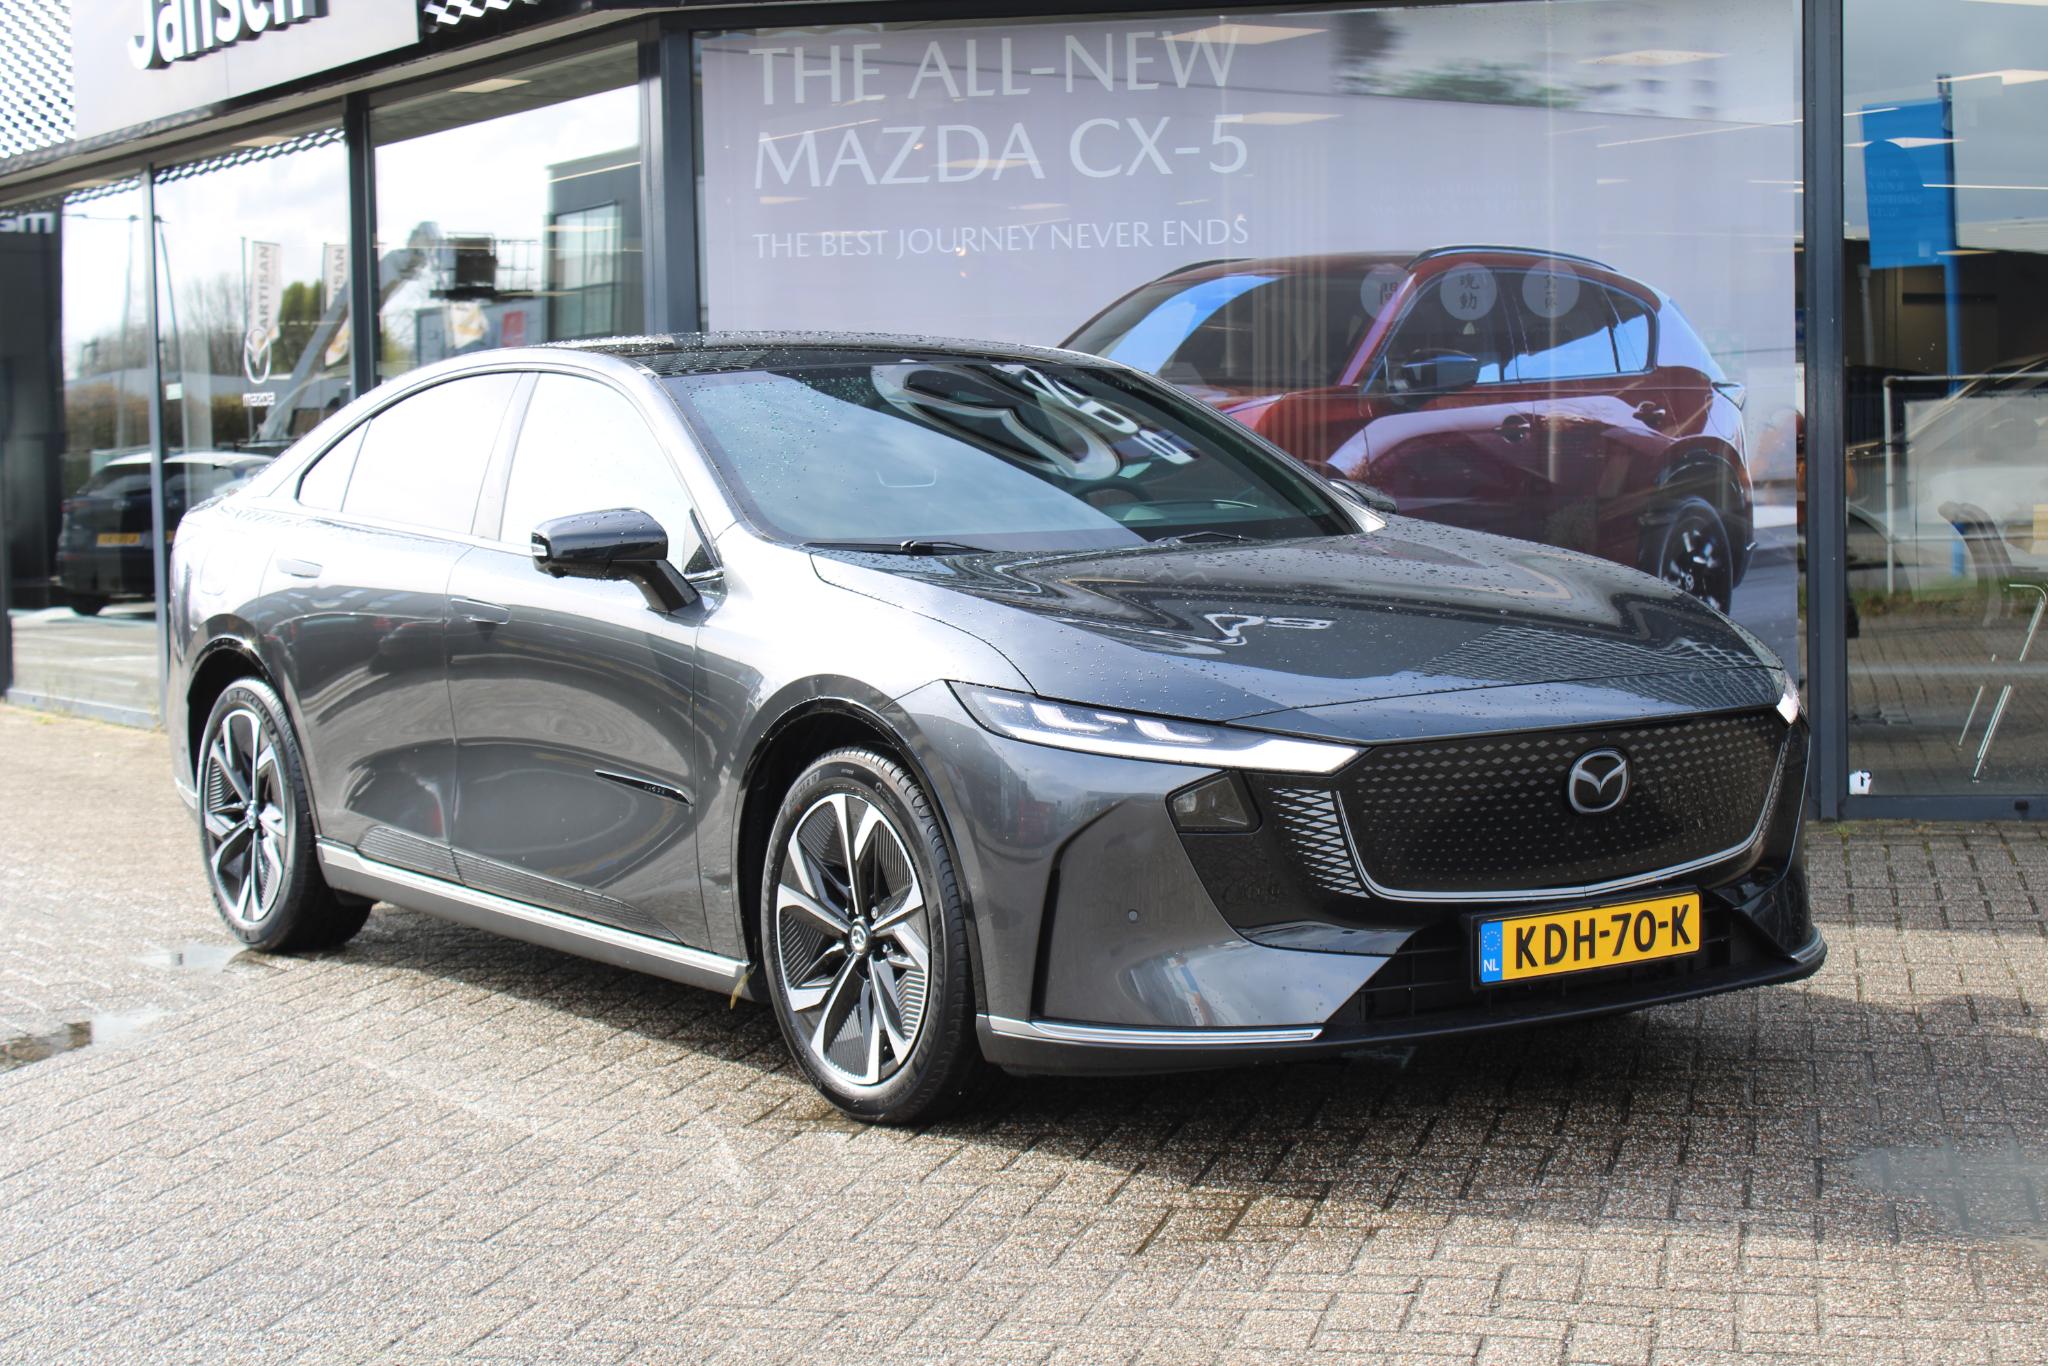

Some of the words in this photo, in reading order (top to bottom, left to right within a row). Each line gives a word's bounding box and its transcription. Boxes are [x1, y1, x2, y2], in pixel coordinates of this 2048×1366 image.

[749, 43, 886, 105] THE
[907, 27, 1239, 99] ALL-NEW
[755, 122, 1046, 189] MAZDA
[1069, 114, 1248, 178] CX-5
[752, 232, 810, 259] THE
[821, 230, 888, 257] BEST
[895, 224, 1040, 260] JOURNEY
[1051, 221, 1152, 249] NEVER
[1163, 218, 1249, 246] ENDS
[1483, 958, 1500, 973] NL
[1515, 903, 1691, 970] KDH-70-K
